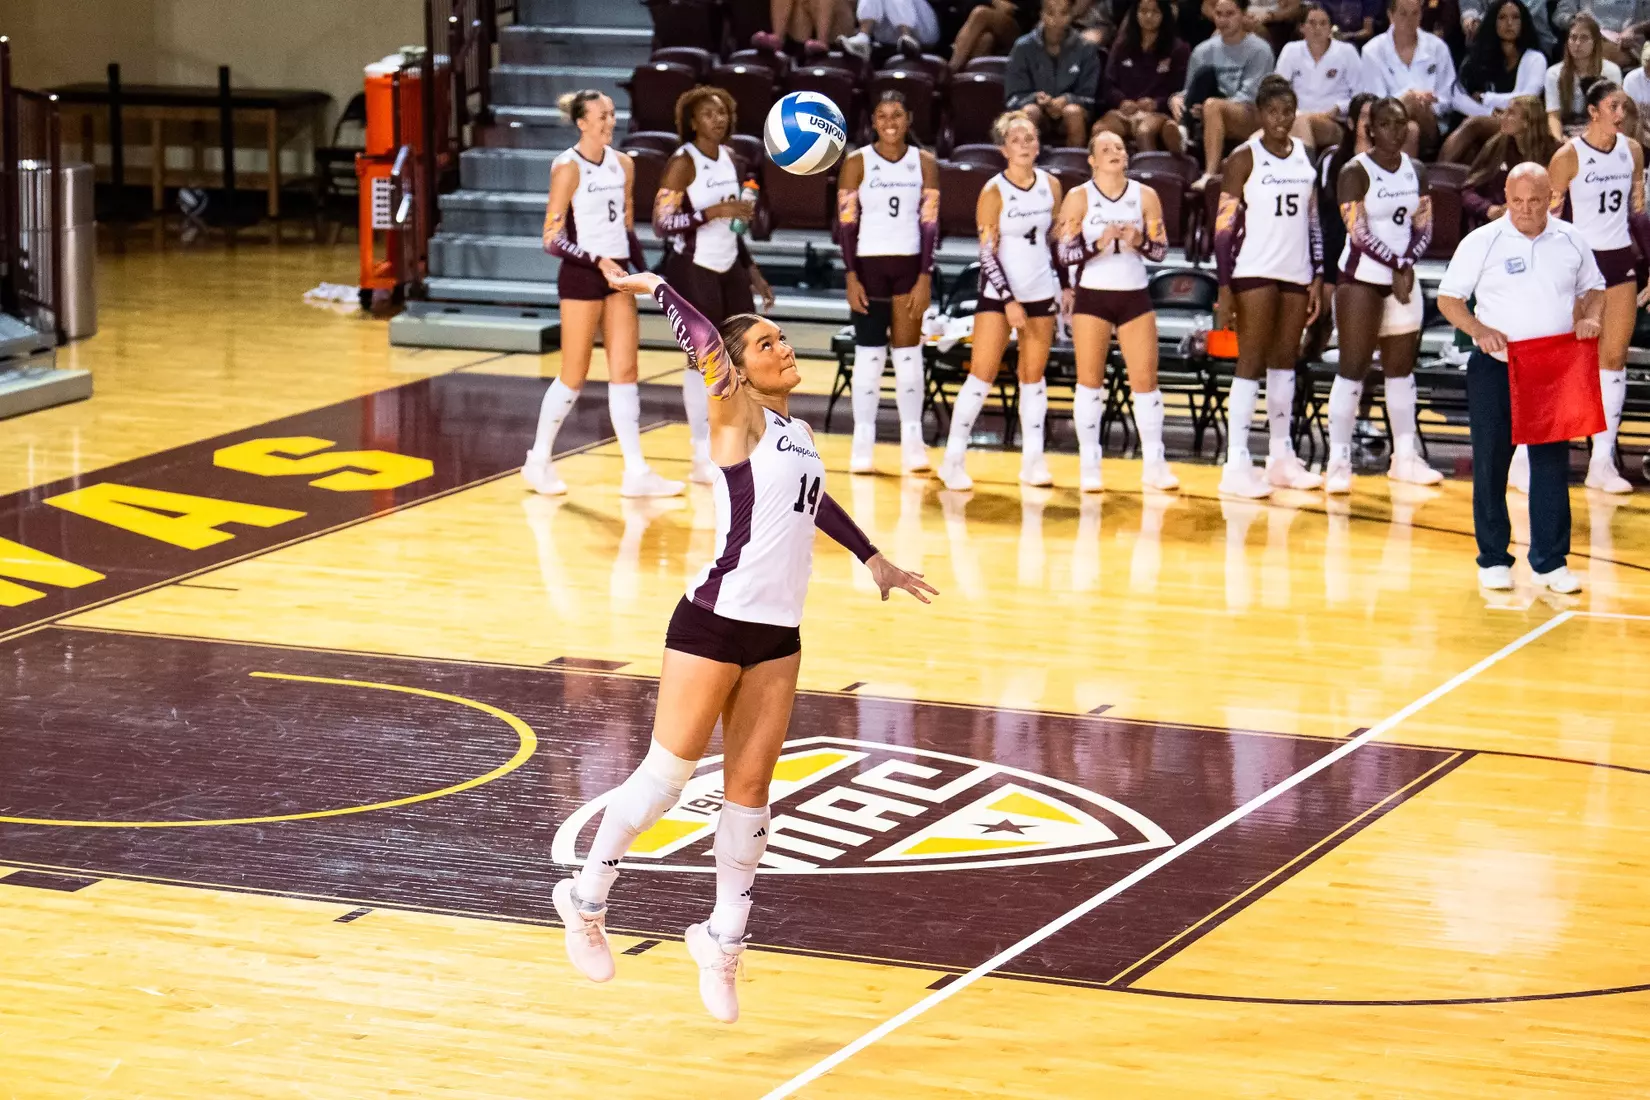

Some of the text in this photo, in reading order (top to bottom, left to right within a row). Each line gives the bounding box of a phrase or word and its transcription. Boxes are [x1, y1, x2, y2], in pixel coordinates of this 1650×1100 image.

[809, 116, 845, 142] molten
[608, 199, 617, 222] 6
[889, 196, 900, 218] 9
[1275, 194, 1299, 217] 15
[1598, 189, 1623, 214] 13
[1023, 225, 1038, 246] 4
[793, 473, 821, 516] 14
[679, 786, 725, 816] 194
[745, 758, 980, 869] MAC
